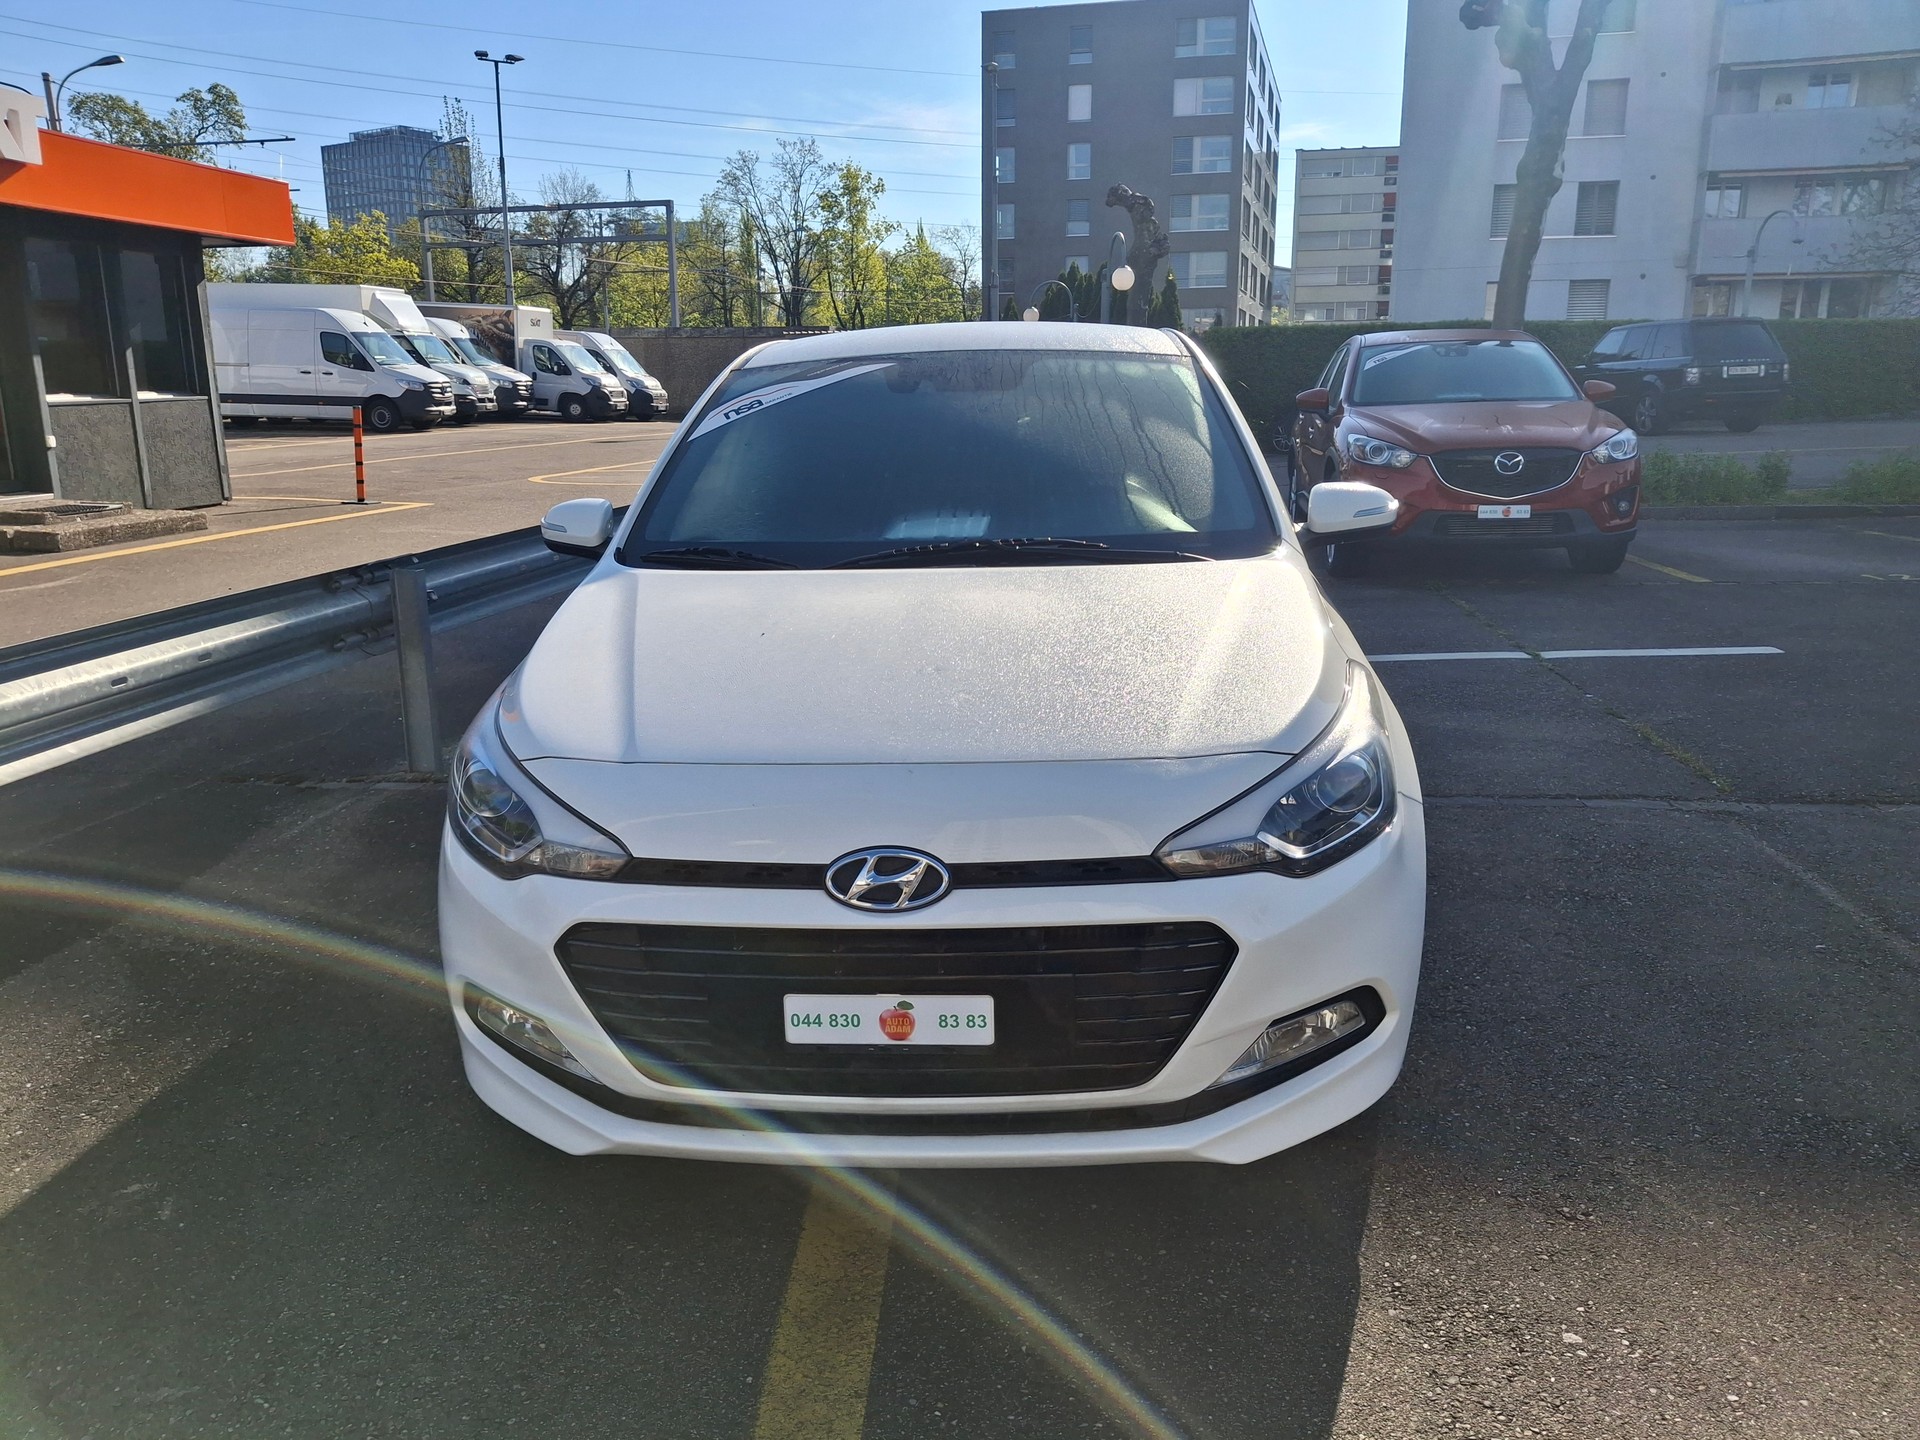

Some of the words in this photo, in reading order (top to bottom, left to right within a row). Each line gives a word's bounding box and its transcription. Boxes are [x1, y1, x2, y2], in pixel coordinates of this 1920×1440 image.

[723, 399, 764, 420] nsa
[790, 1013, 823, 1028] 044
[828, 1013, 861, 1028] 830
[938, 1014, 960, 1028] 83
[966, 1014, 988, 1028] 83
[886, 1017, 910, 1026] AUTO
[885, 1025, 911, 1033] ADAM
